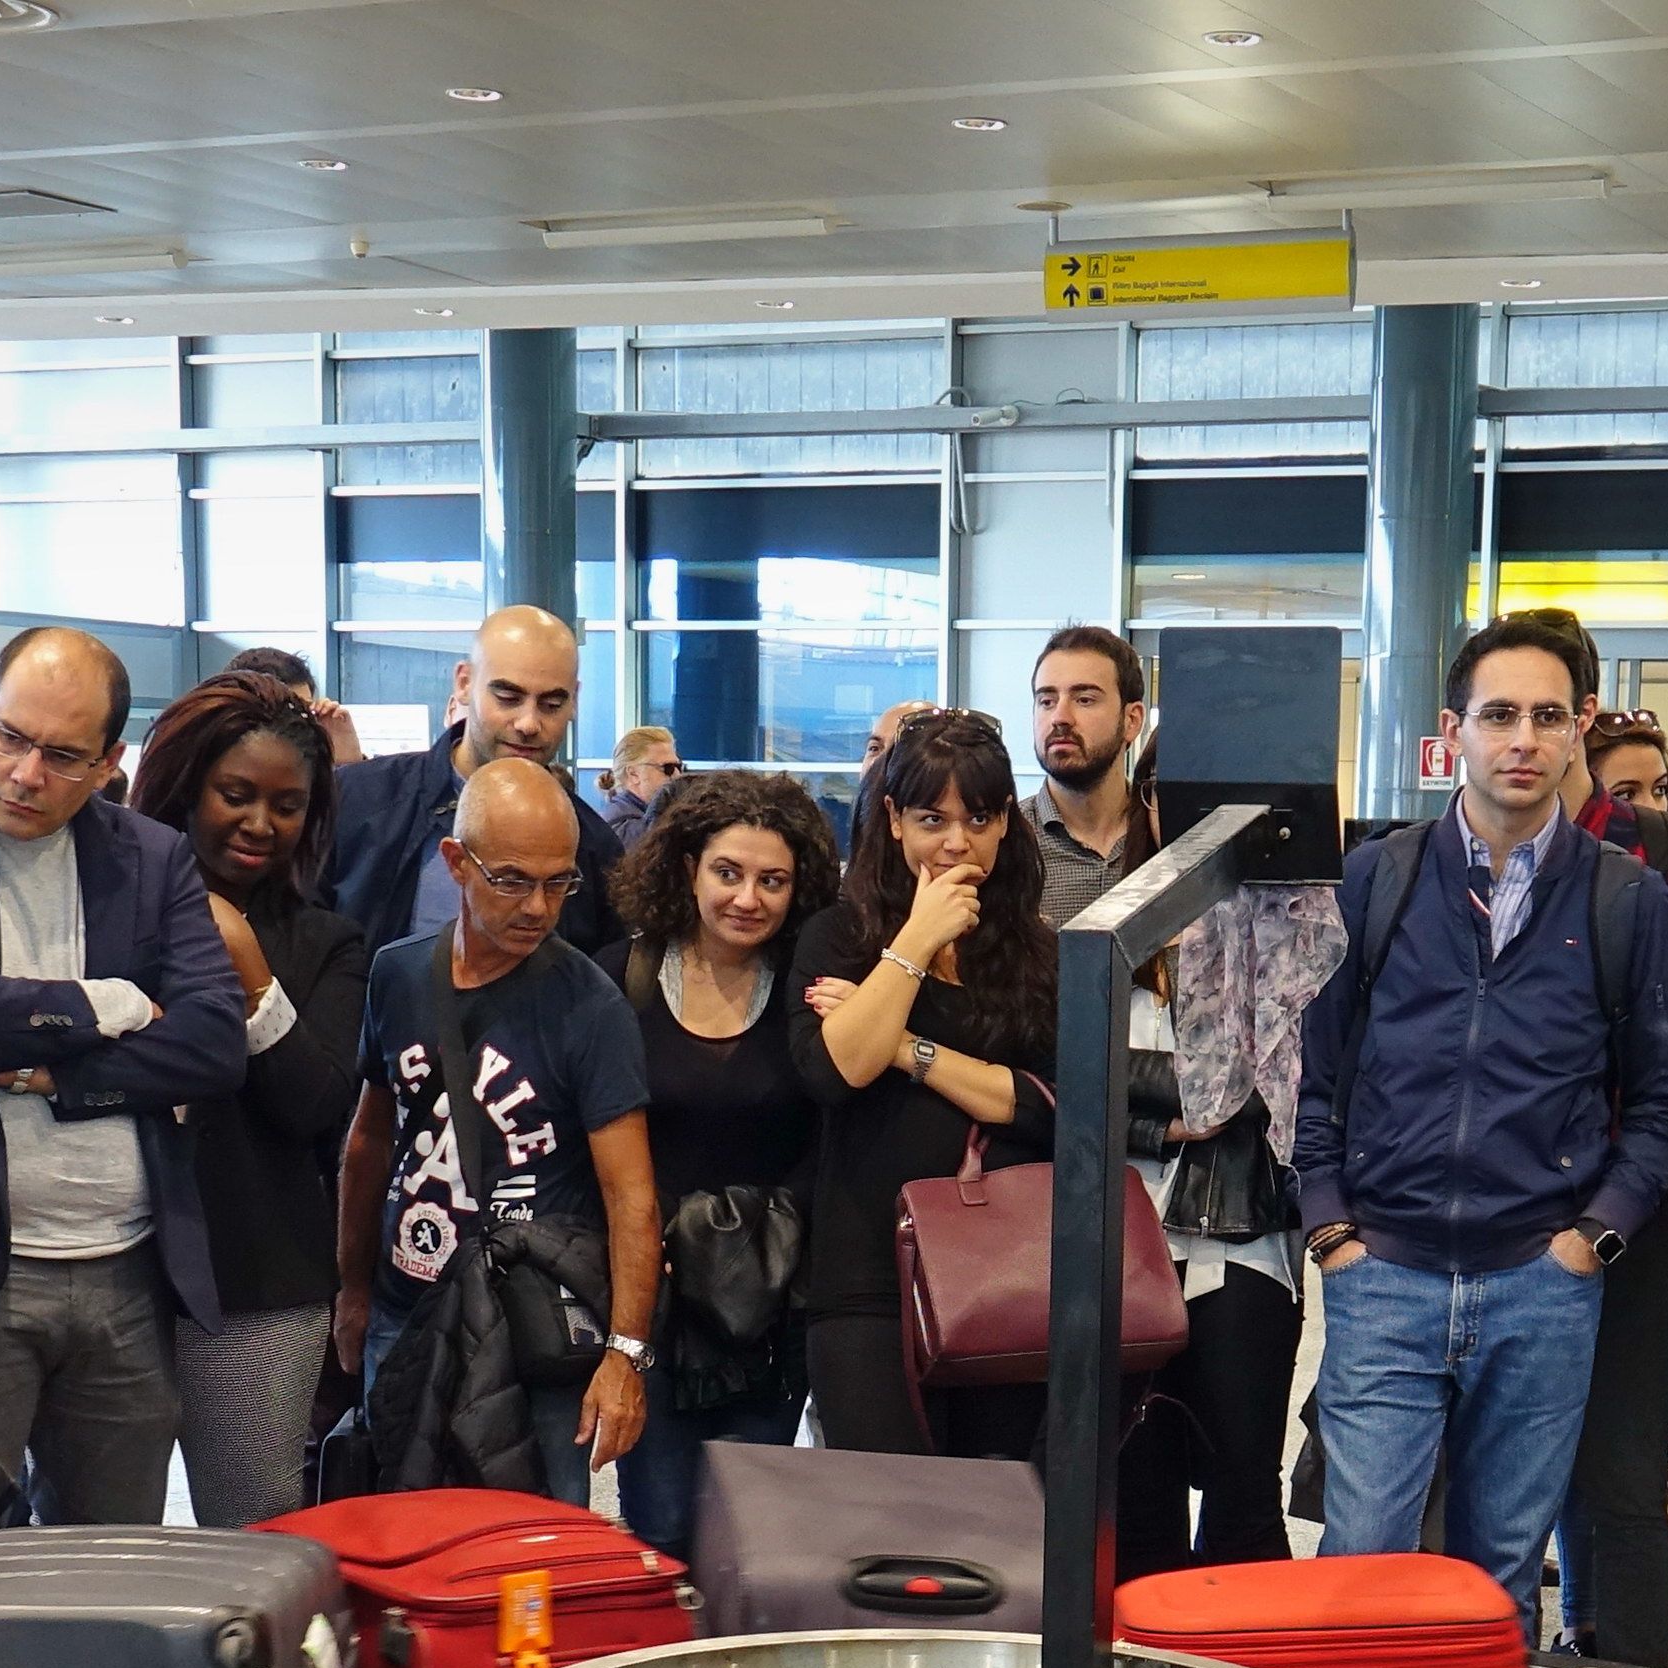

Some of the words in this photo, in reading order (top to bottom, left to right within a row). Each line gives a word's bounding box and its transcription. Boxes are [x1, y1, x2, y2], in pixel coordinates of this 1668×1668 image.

[1133, 281, 1159, 290] Bagagli
[1160, 280, 1207, 288] Internazionali
[1113, 295, 1156, 303] International
[1157, 294, 1189, 303] Baggage
[1190, 292, 1219, 300] Reclaim
[489, 1201, 534, 1222] Trade
